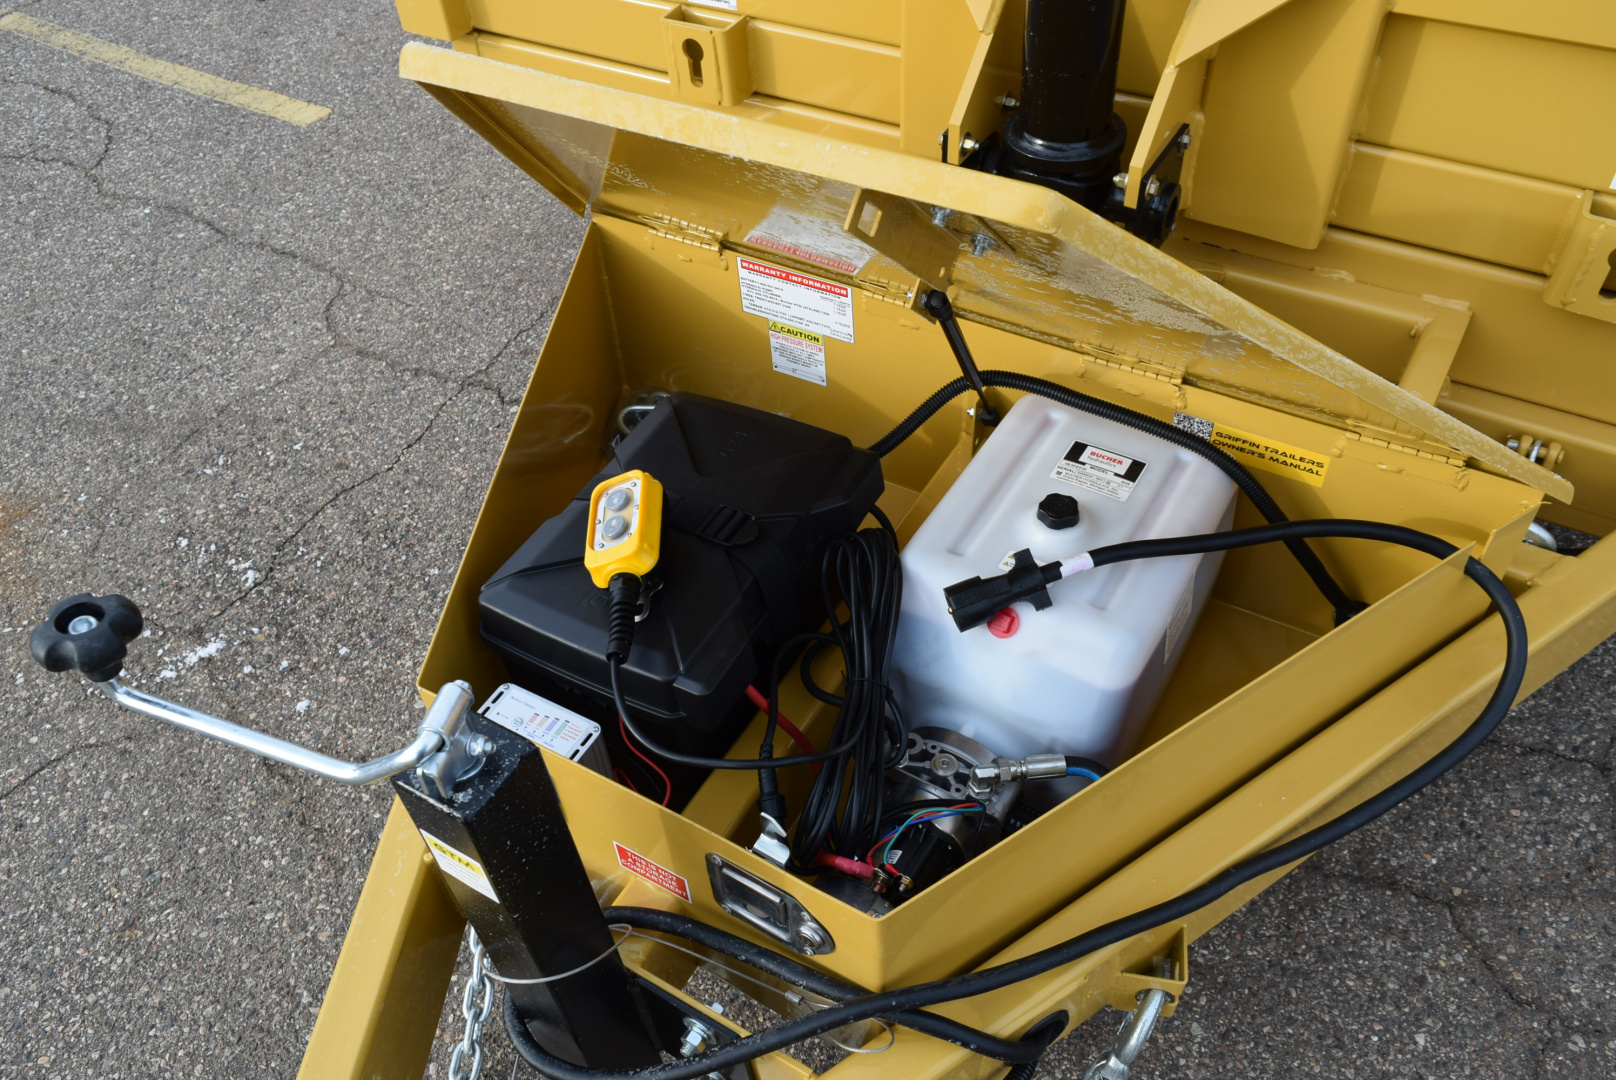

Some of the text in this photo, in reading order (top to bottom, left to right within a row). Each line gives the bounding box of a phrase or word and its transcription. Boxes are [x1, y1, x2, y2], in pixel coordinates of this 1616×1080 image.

[741, 261, 846, 295] WARRANTY INFORMATION
[748, 271, 776, 281] WARRANTY
[804, 287, 841, 300] INFORMATION
[780, 326, 819, 343] CAUTION
[782, 336, 804, 348] PRESSURE
[1086, 455, 1117, 468] hydraulics
[1090, 451, 1124, 465] BUCHER
[1212, 439, 1323, 476] OWNER'S MANUAL
[1216, 431, 1324, 468] GRIFFIN TRAILERS
[1090, 466, 1109, 474] MODEL
[433, 842, 474, 871] GTM
[626, 851, 646, 865] THIS
[659, 868, 677, 881] NOT
[621, 859, 687, 897] COMPARTMENT
[635, 862, 678, 887] STORAGE
